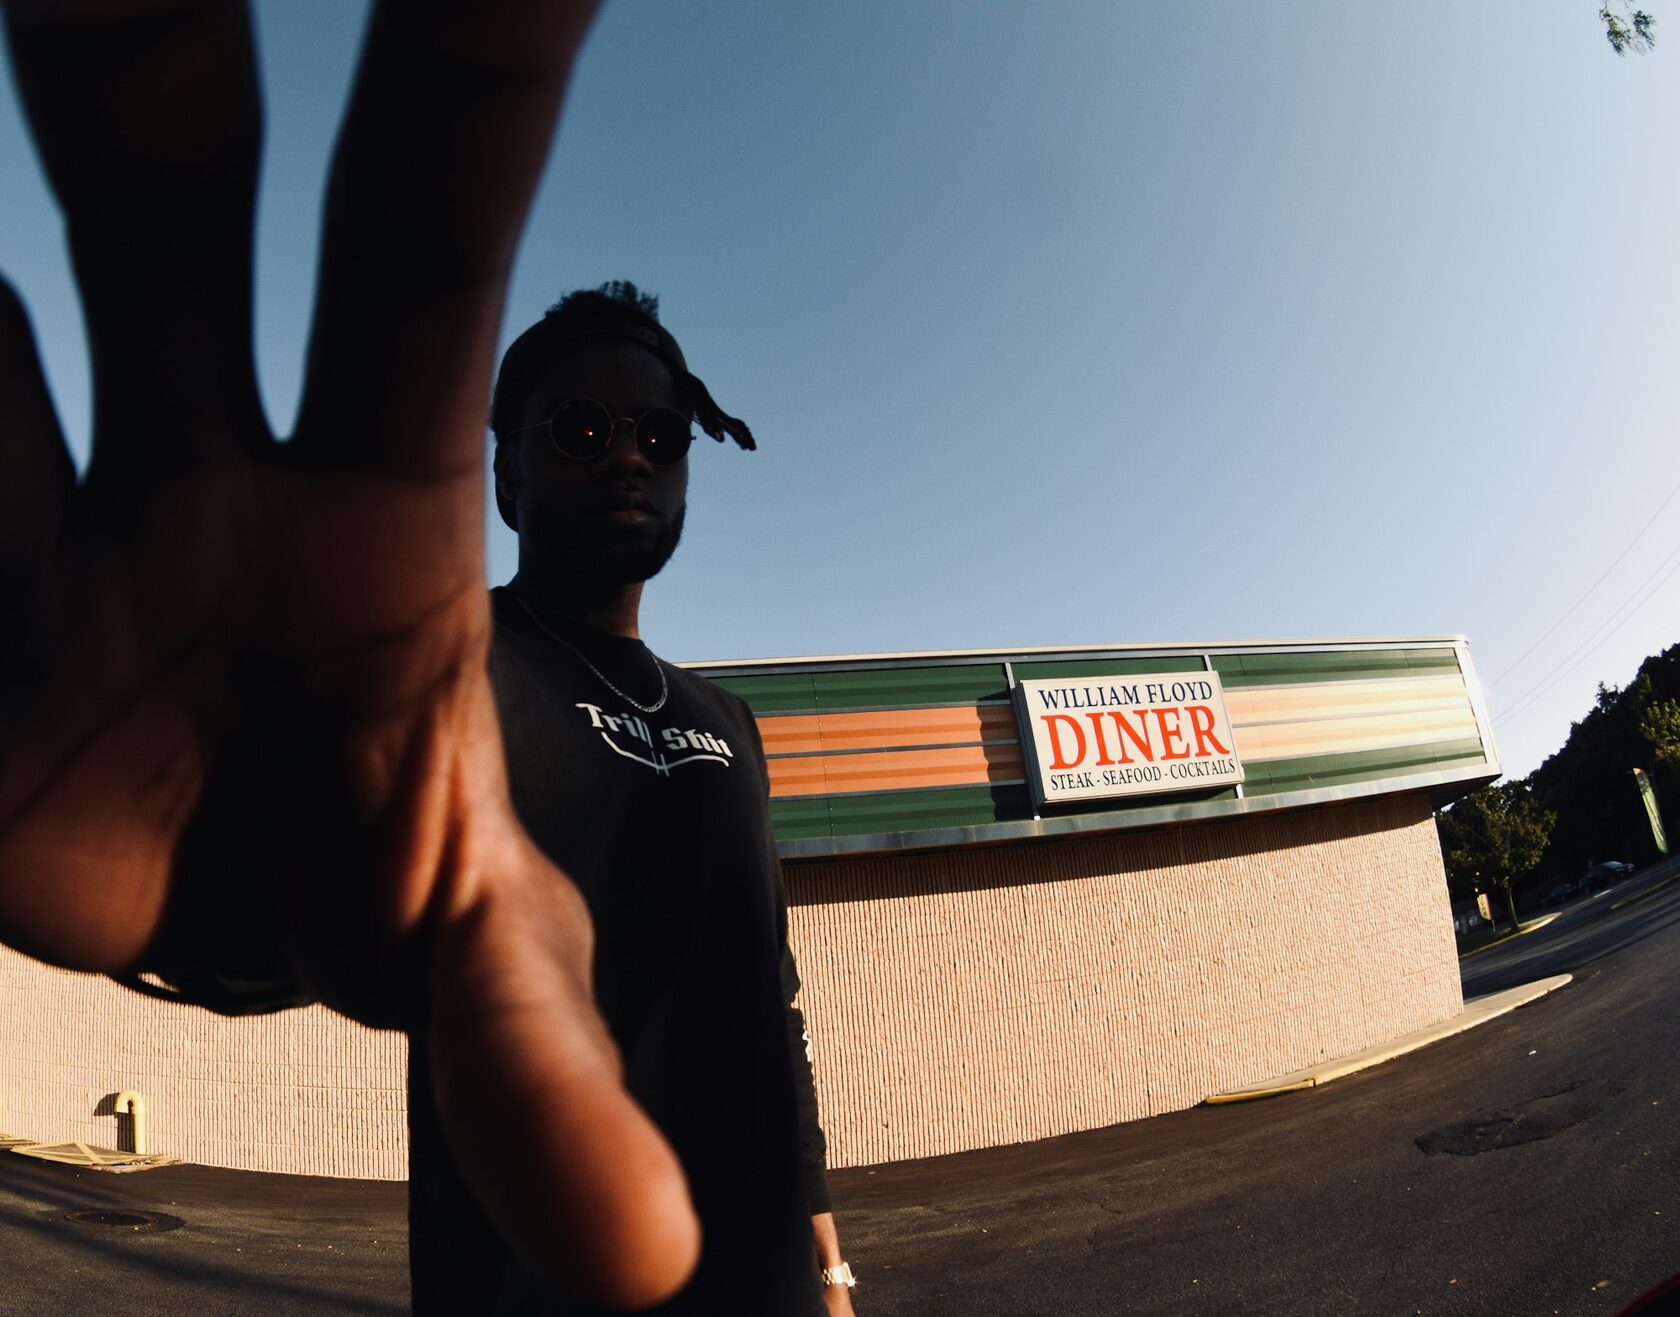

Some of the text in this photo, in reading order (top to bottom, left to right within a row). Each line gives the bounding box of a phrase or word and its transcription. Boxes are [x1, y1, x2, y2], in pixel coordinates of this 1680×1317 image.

[1038, 681, 1213, 710] WILLIAM FLOYD
[575, 702, 653, 749] Trill
[1040, 705, 1230, 770] DINER
[1050, 771, 1094, 791] STEAK
[1103, 766, 1162, 786] SEAFOOD
[1170, 759, 1236, 780] COCKTAILS
